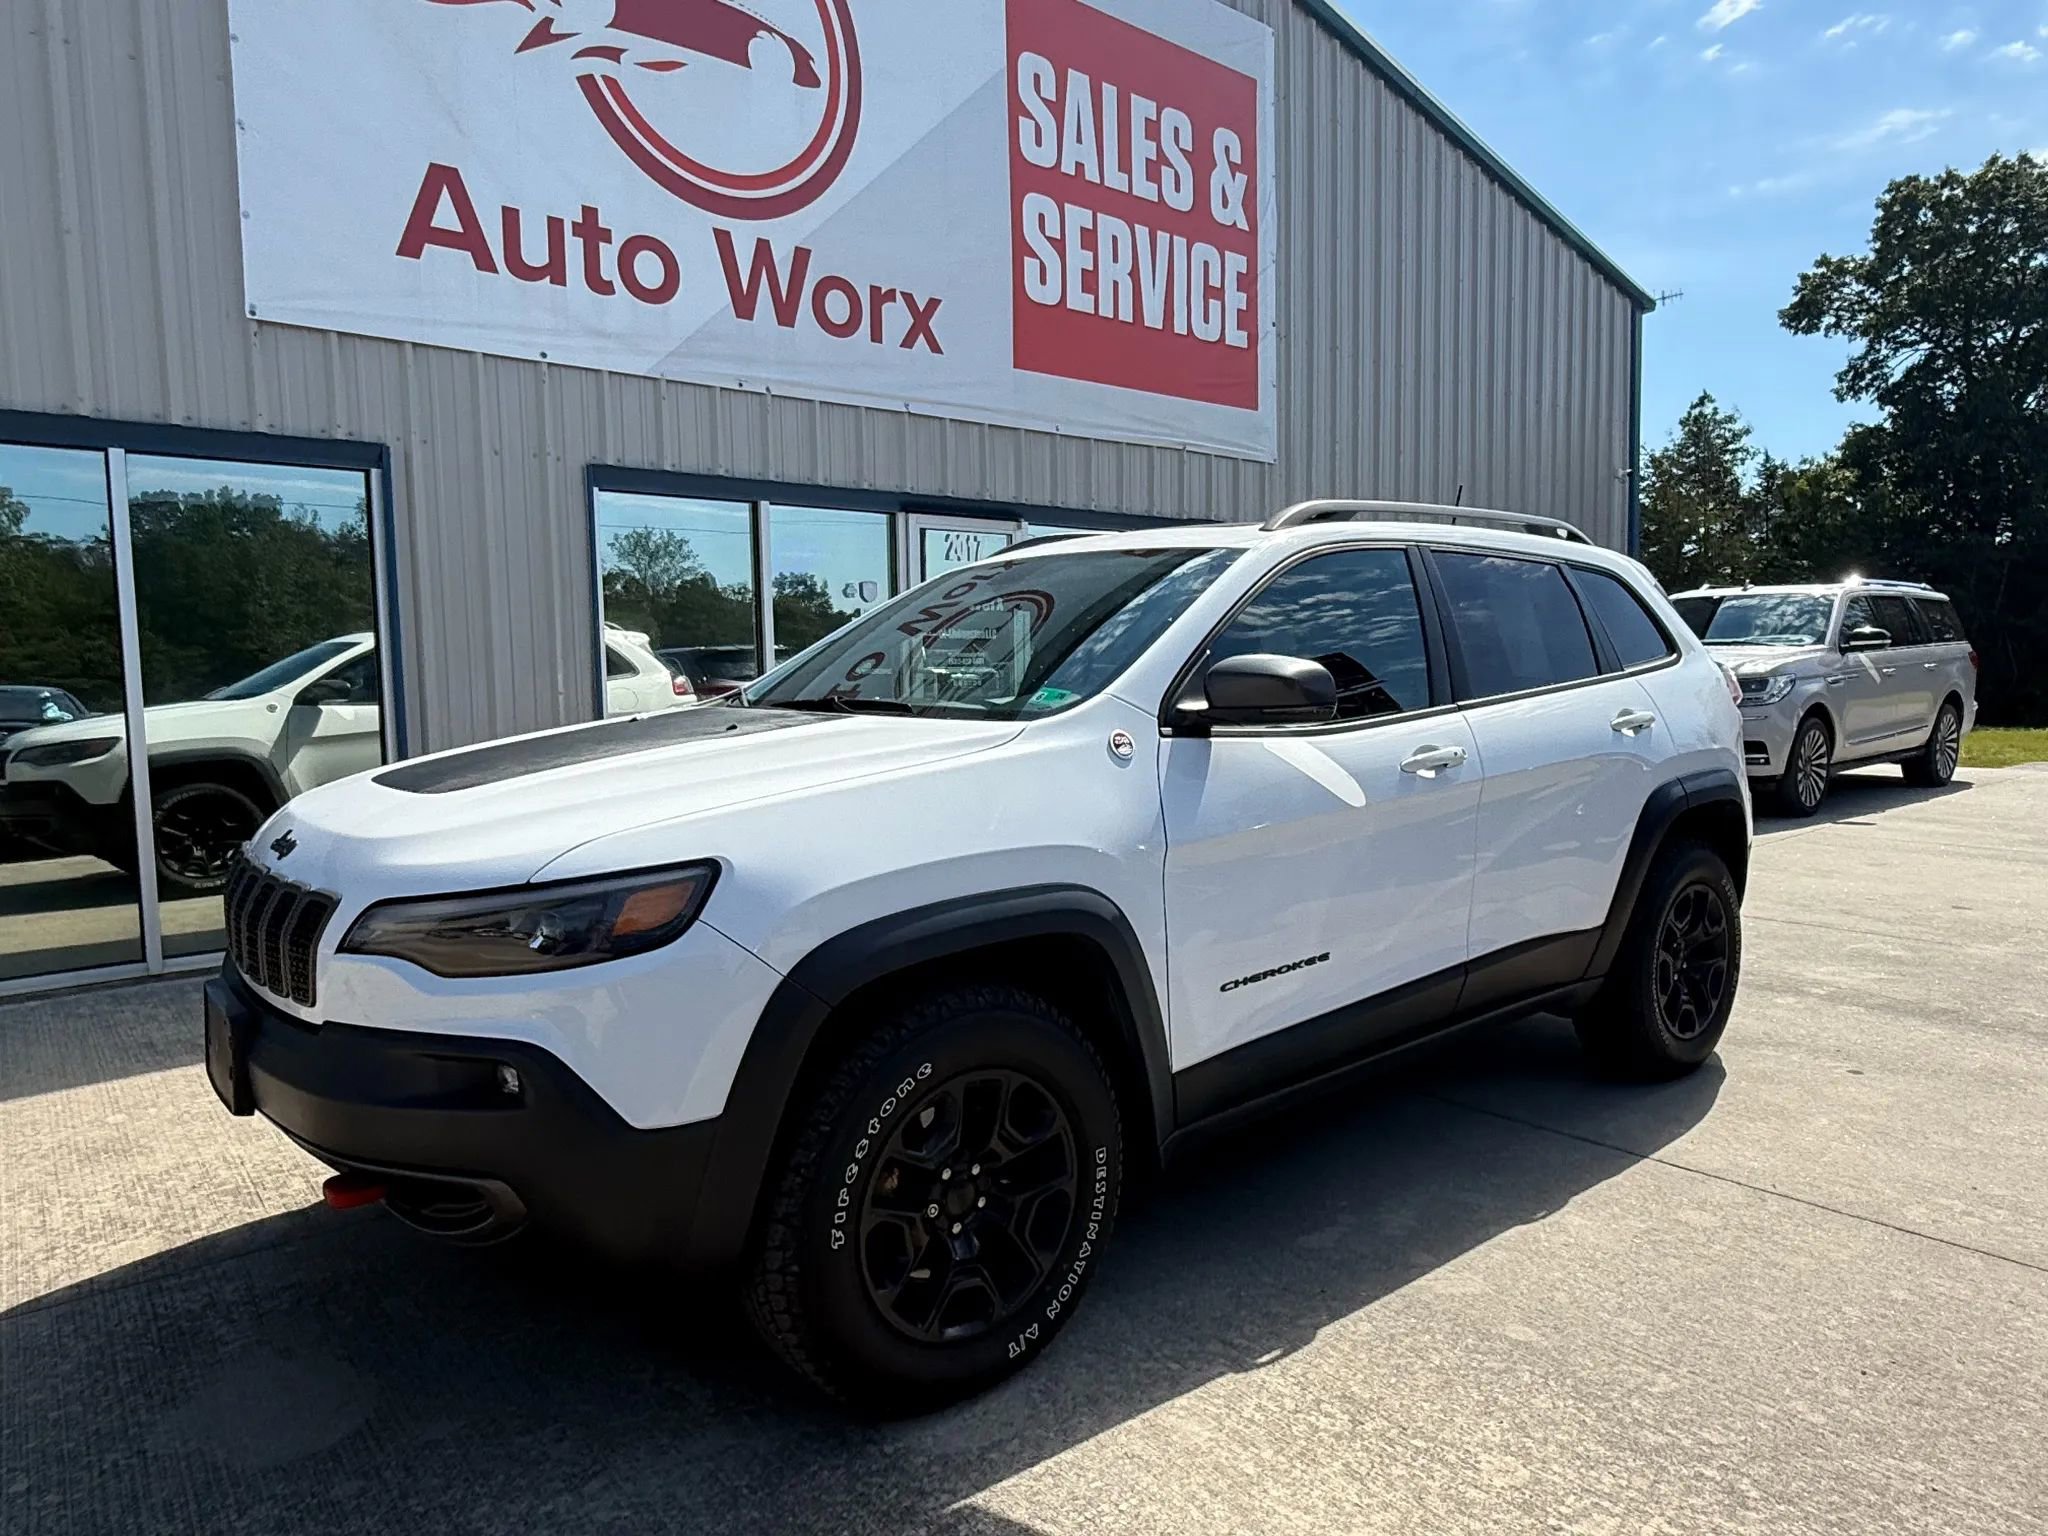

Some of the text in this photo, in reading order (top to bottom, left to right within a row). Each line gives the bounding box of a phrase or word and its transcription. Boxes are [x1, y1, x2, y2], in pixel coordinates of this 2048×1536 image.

[1017, 51, 1250, 232] SALES &
[395, 162, 944, 355] Auto Worx
[1021, 191, 1249, 349] SERVICE
[1219, 951, 1331, 992] CHEROKEE
[1008, 1147, 1107, 1358] DESTINATION A/T
